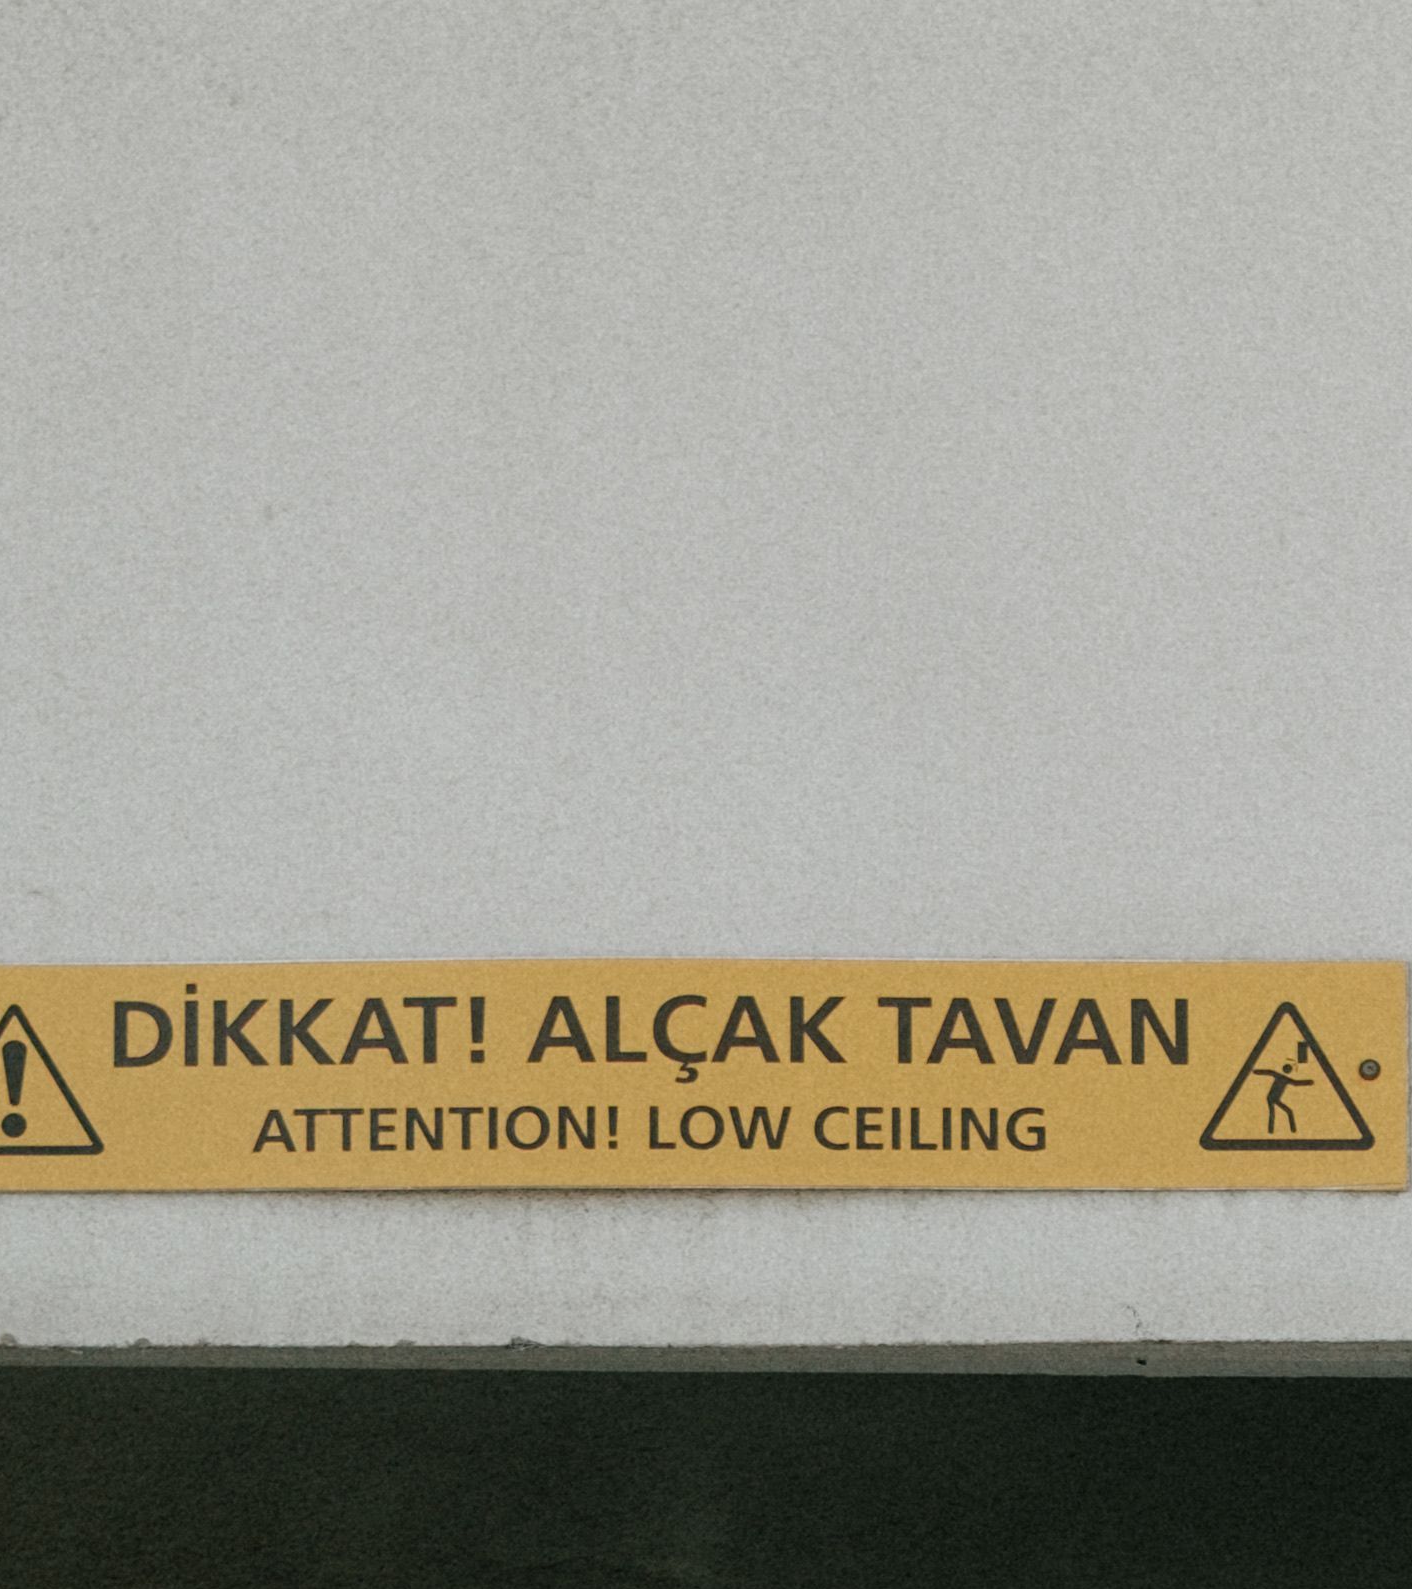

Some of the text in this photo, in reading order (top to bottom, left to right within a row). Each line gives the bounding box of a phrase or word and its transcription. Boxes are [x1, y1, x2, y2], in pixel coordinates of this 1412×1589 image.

[113, 983, 1189, 1084] DİKKAT! ALÇAK TAVAN
[252, 1105, 1046, 1153] ATTENTION! LOW CEILING
